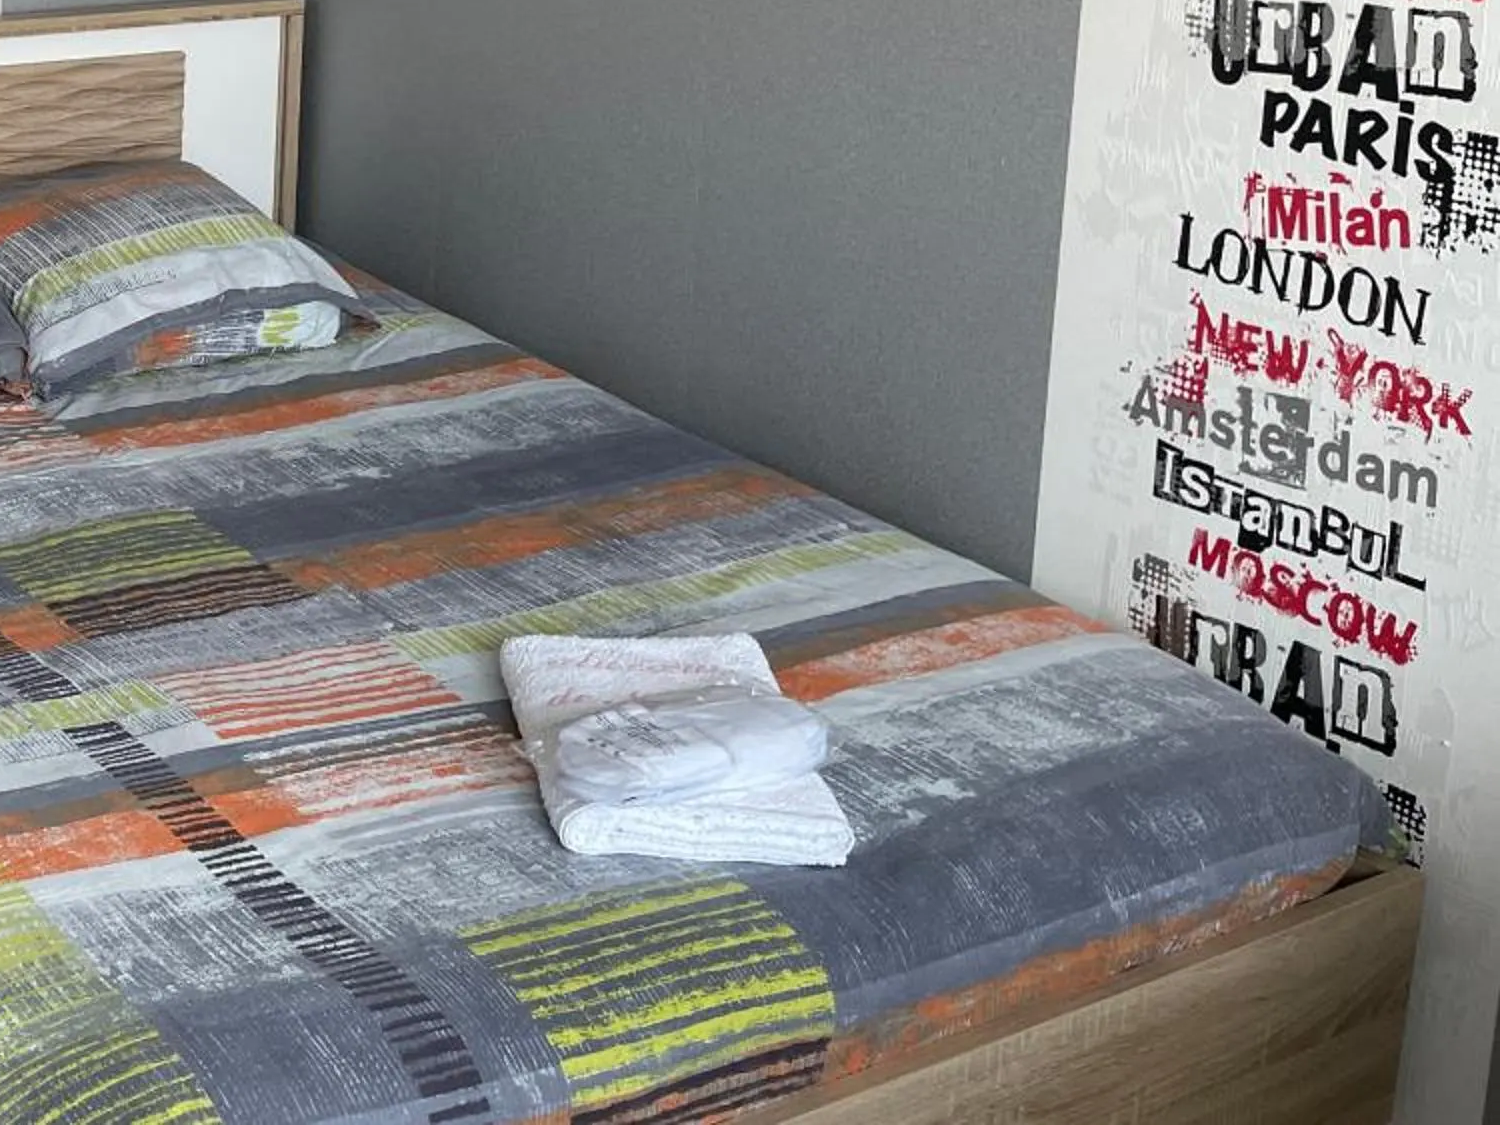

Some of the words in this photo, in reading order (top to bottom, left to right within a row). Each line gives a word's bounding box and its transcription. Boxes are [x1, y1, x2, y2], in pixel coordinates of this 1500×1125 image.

[1173, 212, 1431, 345] LONDON
[1268, 188, 1410, 249] Milan
[1192, 292, 1308, 383] NEW
[1327, 328, 1472, 437] YORK
[1129, 378, 1437, 507] Amsterdam
[1189, 527, 1419, 665] MOSCOW
